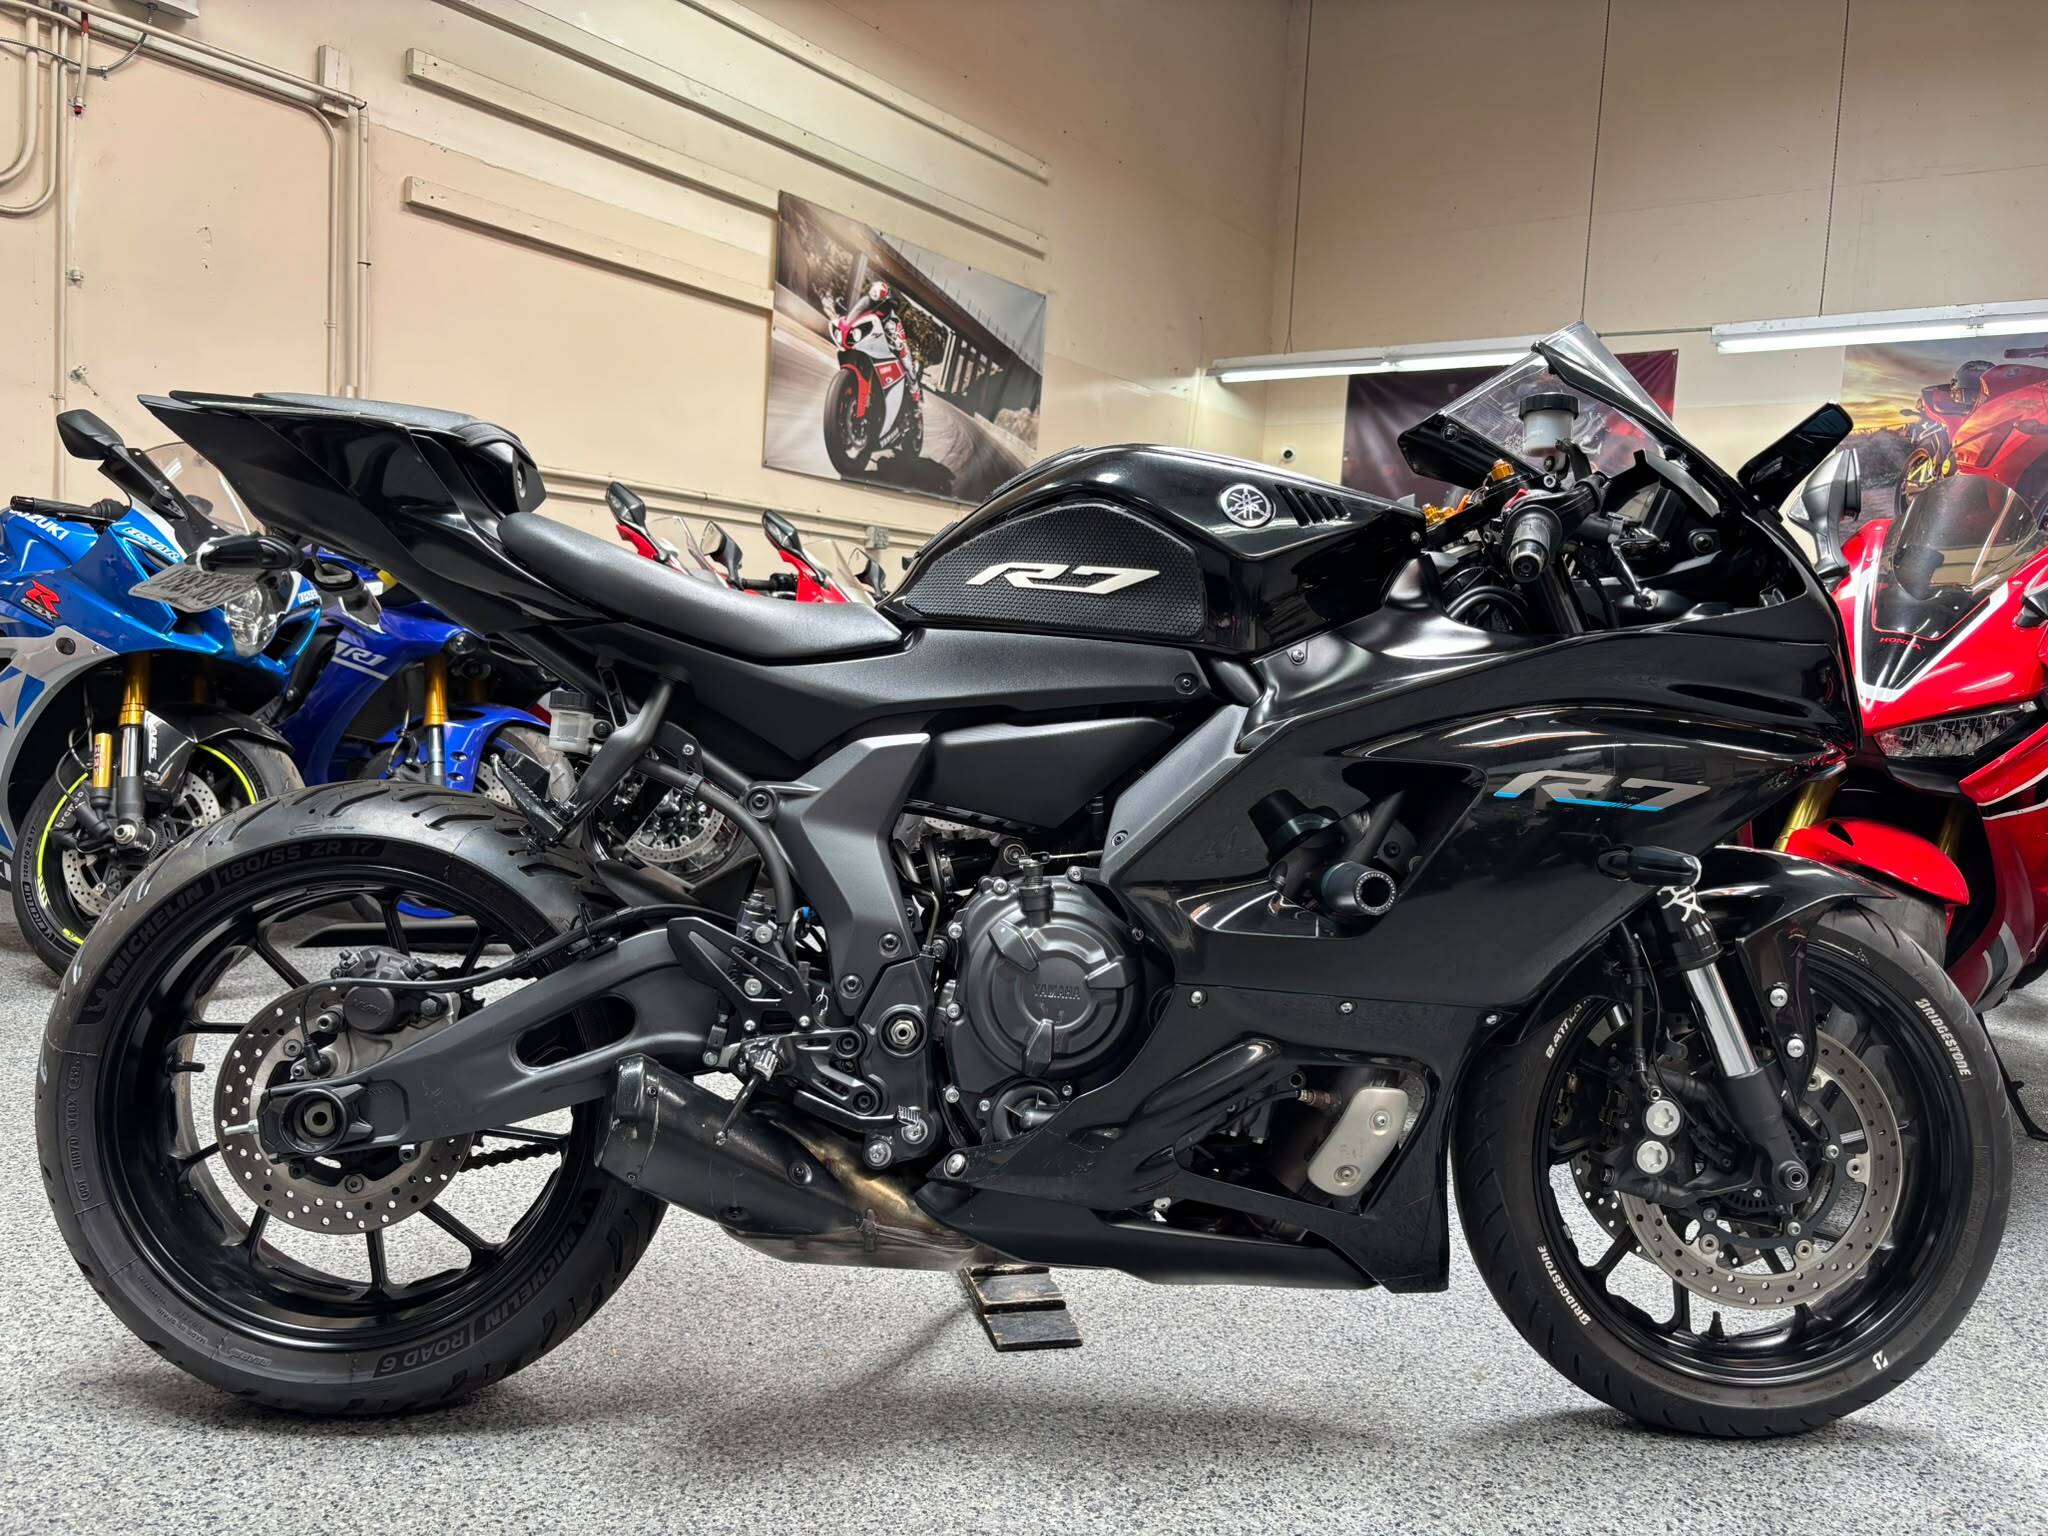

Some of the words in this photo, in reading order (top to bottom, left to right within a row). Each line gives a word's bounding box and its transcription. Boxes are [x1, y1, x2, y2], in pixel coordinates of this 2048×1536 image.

[9, 509, 71, 541] UZUKI
[26, 580, 60, 617] R
[966, 562, 1160, 595] R7
[1493, 769, 1711, 812] R7
[105, 884, 205, 985] MICHELIN
[219, 845, 300, 883] 180/55
[310, 840, 342, 857] ZR
[349, 840, 375, 855] 17
[1032, 983, 1081, 1000] YAMAHA
[1545, 998, 1591, 1059] BATTLA
[1914, 998, 1972, 1076] BRIDGESTONE
[484, 1226, 579, 1331] MICHELIN
[1537, 1245, 1592, 1326] BRIDGESTONE
[380, 1355, 396, 1373] 6
[403, 1327, 466, 1367] ROAD
